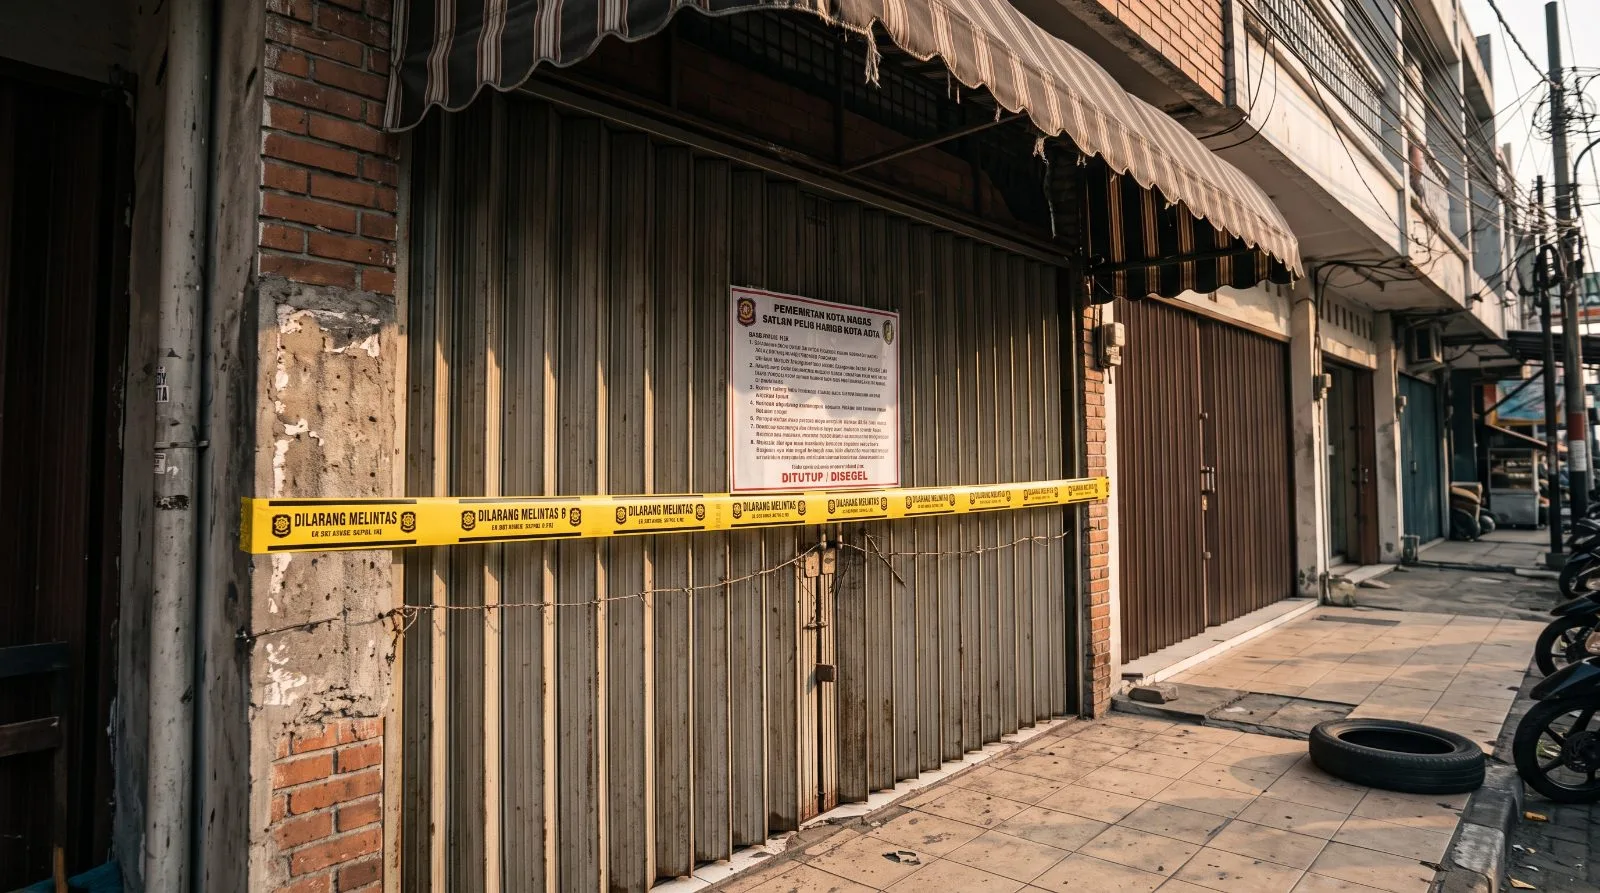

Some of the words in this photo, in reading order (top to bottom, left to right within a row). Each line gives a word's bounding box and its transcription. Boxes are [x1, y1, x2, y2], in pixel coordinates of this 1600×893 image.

[826, 312, 845, 323] KOTA
[847, 315, 872, 326] NAGAS
[844, 326, 862, 336] KOTA
[782, 472, 823, 483] DITUTUP
[831, 471, 868, 481] DISEGEL
[628, 505, 661, 516] DILARANG
[662, 504, 694, 515] MELINTAS
[743, 501, 770, 511] DILARANG
[771, 500, 796, 510] MELINTAS
[294, 512, 346, 527] DILARANG
[349, 511, 397, 525] MELINTAS
[478, 509, 519, 521] DILARANG
[521, 508, 559, 520] MELINTAS
